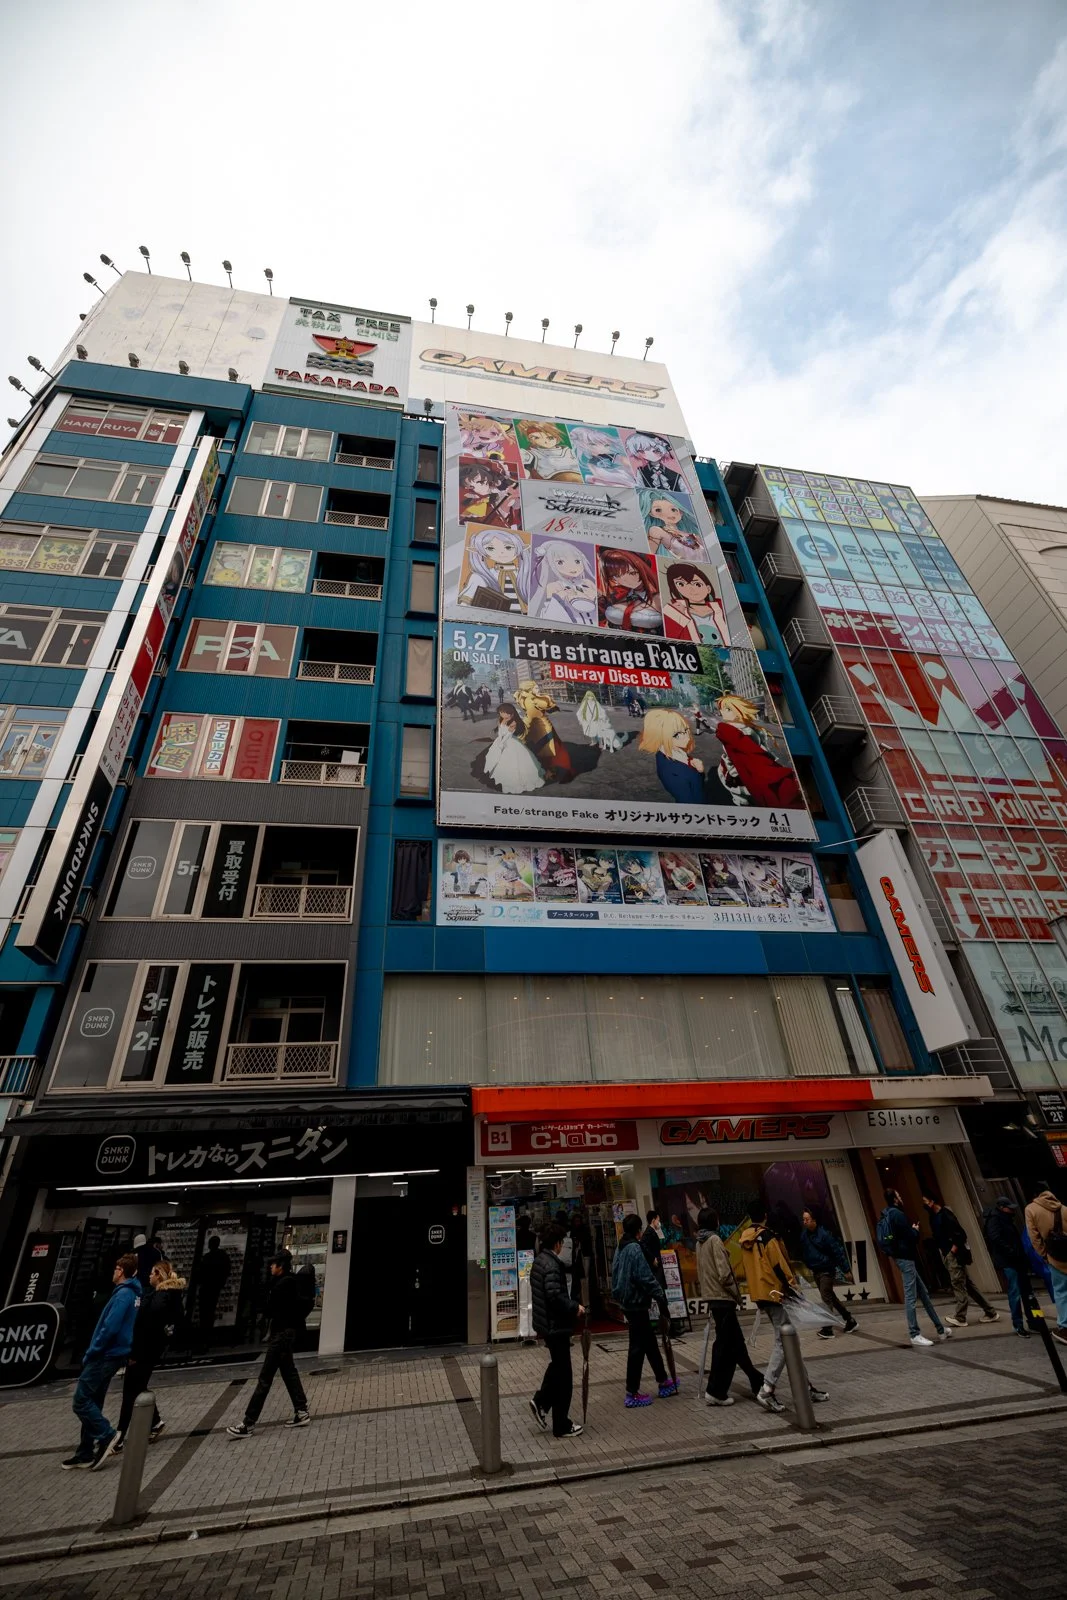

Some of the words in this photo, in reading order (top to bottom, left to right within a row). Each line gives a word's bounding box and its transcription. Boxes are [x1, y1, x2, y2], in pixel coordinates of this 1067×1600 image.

[300, 308, 341, 323] TAX
[355, 317, 401, 333] FREE
[275, 368, 399, 397] TAKARADA
[419, 349, 667, 400] GAMERS
[63, 420, 137, 433] HARERUYA
[546, 499, 617, 519] Schwarz
[568, 529, 634, 542] Anniversary
[842, 543, 901, 560] EAST
[194, 635, 281, 661] PSA
[453, 630, 499, 651] 5.27
[453, 651, 469, 662] ON
[472, 653, 500, 666] SALE
[513, 636, 562, 661] Fate
[566, 641, 646, 670] strange
[645, 643, 699, 672] Fake
[555, 664, 605, 685] Blu-ray
[609, 668, 640, 685] Disc
[642, 671, 669, 688] Box
[160, 722, 198, 770] 麻雀
[494, 804, 569, 820] Fate/strange
[572, 809, 599, 820] Fake
[604, 808, 761, 828] オリジナルサウンドトラック
[905, 793, 985, 817] CARD
[769, 812, 791, 827] 4.1
[54, 801, 99, 921] SNKRDUNK
[177, 860, 200, 876] 5F
[218, 840, 246, 901] 買取受付
[879, 876, 936, 996] GAMERS
[142, 992, 169, 1012] 3F
[182, 975, 218, 1070] トレカ販売
[132, 1031, 160, 1051] 2F
[491, 1131, 509, 1145] B1
[530, 1131, 618, 1149] C-labo
[660, 1114, 835, 1145] GAMERS
[101, 1154, 128, 1164] DUNK
[104, 1145, 130, 1154] SNKR
[148, 1125, 348, 1176] トレカならスニダン
[24, 1272, 40, 1303] SNKR
[0, 1344, 45, 1364] UNK
